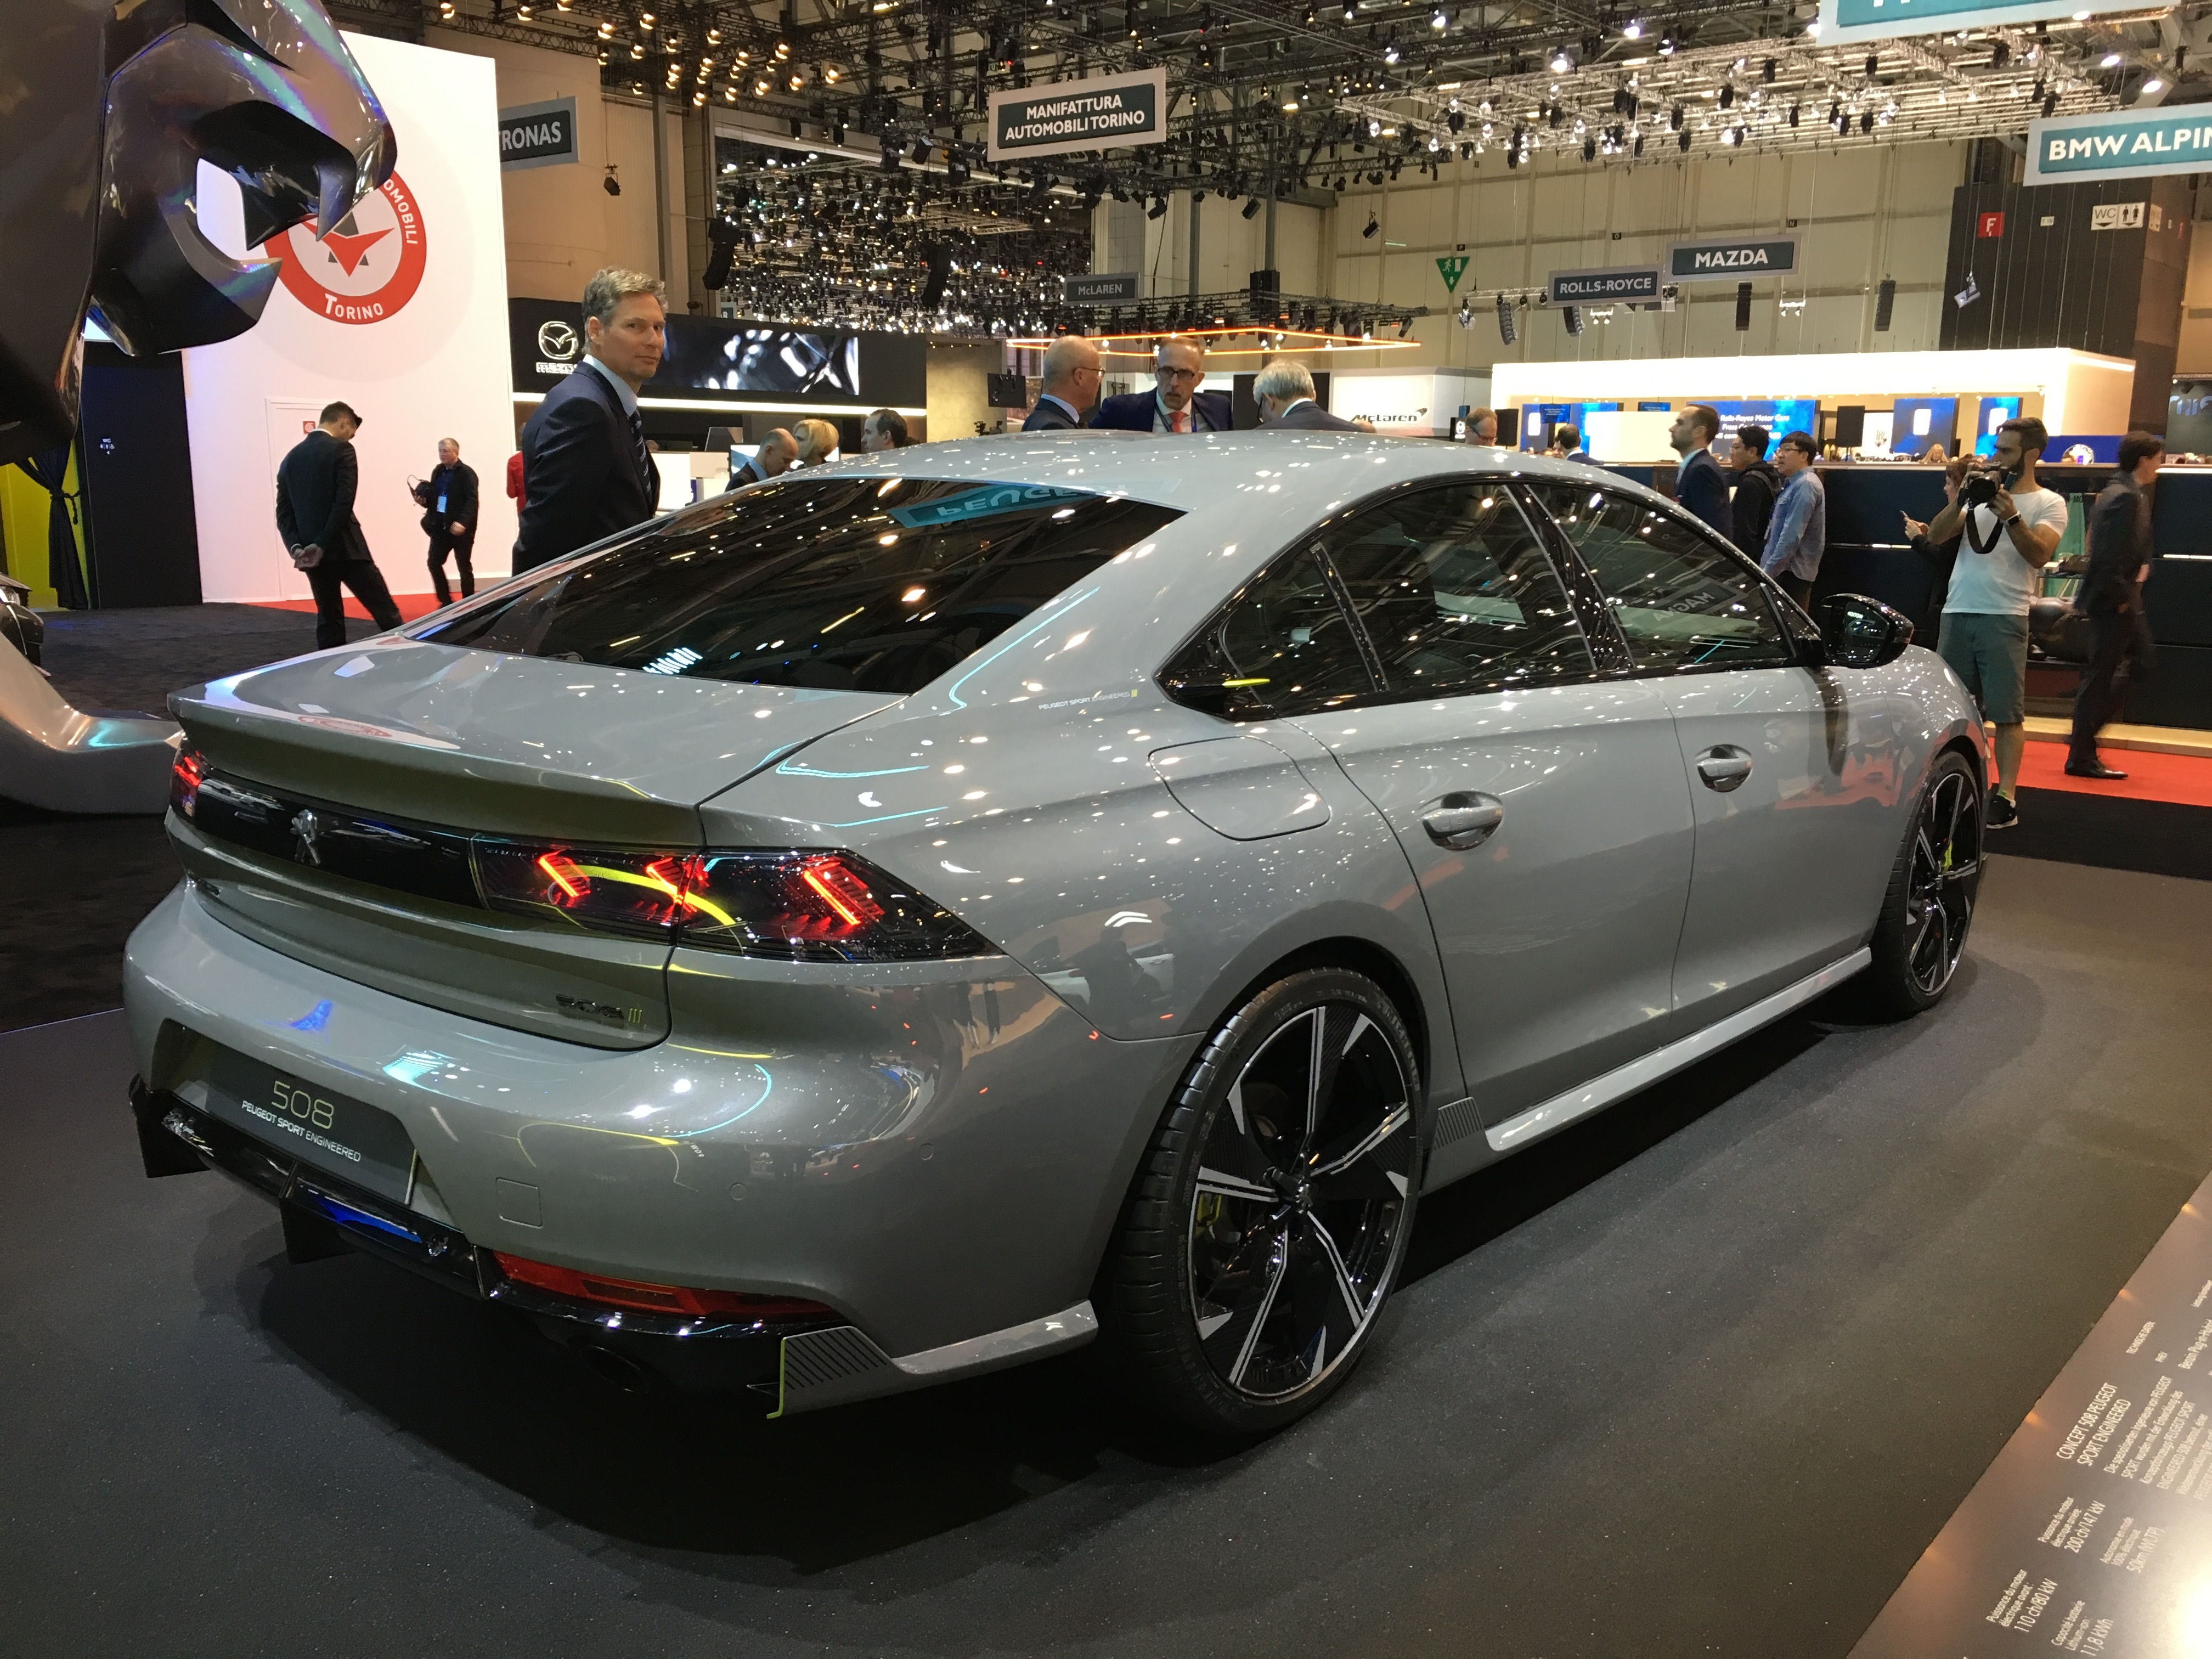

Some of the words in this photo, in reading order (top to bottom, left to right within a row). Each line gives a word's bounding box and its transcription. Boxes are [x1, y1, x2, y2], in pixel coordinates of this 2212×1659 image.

[1026, 94, 1122, 120] MANIFATTURA
[499, 121, 561, 151] RONAS
[1005, 117, 1088, 140] AUTOMOBILI
[1091, 110, 1145, 129] TORINO
[2049, 134, 2128, 161] BMW
[383, 179, 418, 245] OMOBILI
[2095, 207, 2116, 219] WC
[1695, 249, 1768, 268] MAZDA
[1078, 284, 1122, 295] McLAREN
[1559, 277, 1652, 294] ROLLS-ROYCE
[1038, 701, 1069, 710] PEUGEOT
[1069, 697, 1091, 706] SPORT
[271, 1080, 335, 1130] 508
[241, 1100, 277, 1124] PEUGEOT
[277, 1117, 306, 1137] SPORT
[305, 1130, 362, 1163] ENGINEERED
[2178, 1353, 2197, 1369] Benzin
[2087, 1383, 2117, 1414] PEUGEOT
[2077, 1440, 2103, 1466] SPORT
[2092, 1400, 2131, 1442] ENGINEERED
[2078, 1413, 2098, 1426] 508
[2103, 1464, 2118, 1473] Die
[2151, 1376, 2171, 1398] PEUGEOT
[2164, 1417, 2185, 1441] PEUGEOT
[2177, 1401, 2194, 1418] SPORT
[2056, 1425, 2089, 1459] CONCEPT
[2121, 1459, 2140, 1479] SPORT
[2157, 1454, 2185, 1489] ENGINEERED
[2038, 1520, 2060, 1542] Puissance
[2064, 1537, 2084, 1553] 200
[2087, 1500, 2105, 1514] kW
[1986, 1596, 2011, 1622] Puissance
[2010, 1569, 2027, 1589] moteur
[2014, 1616, 2035, 1632] 110
[2026, 1593, 2050, 1616] ch/80
[2038, 1578, 2057, 1594] kW
[2091, 1619, 2113, 1638] kWh
[2080, 1637, 2103, 1656] 11,8
